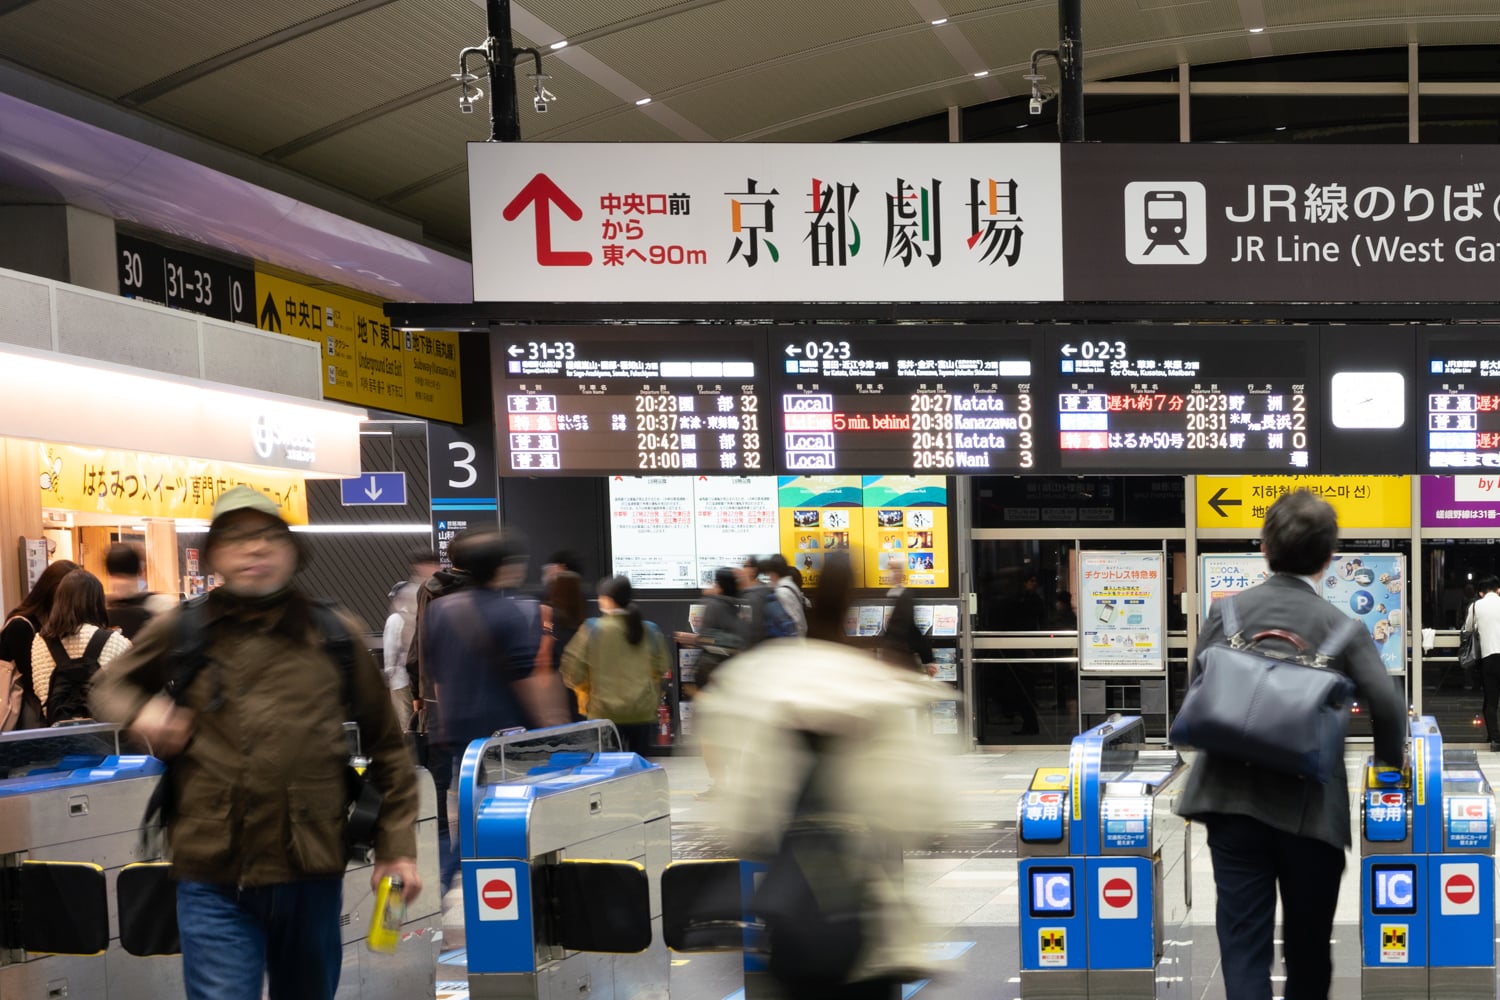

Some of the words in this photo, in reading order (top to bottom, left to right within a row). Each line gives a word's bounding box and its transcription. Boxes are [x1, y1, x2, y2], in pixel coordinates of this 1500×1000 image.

[599, 193, 690, 216] 中央口前
[601, 218, 644, 240] から
[723, 177, 1025, 268] 京都劇場
[602, 243, 707, 266] 東へ90m
[1231, 236, 1264, 263] JR
[1276, 235, 1340, 263] Line
[1352, 234, 1444, 267] (West
[123, 250, 142, 288] 30
[168, 263, 212, 305] 31-33
[233, 281, 242, 313] 0
[285, 296, 322, 331] 中央口
[357, 316, 401, 352] 地下東口
[636, 396, 677, 412] 20:23
[741, 396, 758, 412] 32
[790, 396, 829, 411] Local
[911, 396, 952, 411] 20:27
[954, 396, 1003, 411] Katata
[1018, 395, 1031, 411] 3
[1187, 395, 1227, 411] 20:23
[1293, 395, 1305, 411] 2
[636, 415, 677, 430] 20:37
[742, 415, 757, 430] 31
[834, 415, 845, 430] 5
[873, 415, 910, 430] behind
[912, 415, 952, 430] 20:38
[955, 415, 1017, 430] Kanazawa
[1018, 415, 1031, 430] 0
[1187, 415, 1227, 430] 20:31
[1294, 415, 1305, 430] 2
[638, 434, 678, 449] 20:42
[743, 434, 759, 449] 33
[790, 434, 830, 449] Local
[913, 433, 953, 448] 20:41
[956, 434, 1005, 448] Katata
[1019, 433, 1032, 448] 3
[1109, 433, 1184, 448] はるか50号
[1187, 433, 1227, 448] 20:34
[1294, 433, 1305, 448] 0
[448, 442, 477, 488] 3
[639, 453, 679, 468] 21:00
[744, 452, 760, 468] 32
[791, 452, 831, 467] Local
[913, 452, 954, 467] 20:56
[956, 452, 989, 467] Wani
[1020, 452, 1032, 467] 3
[1353, 485, 1371, 499] 선)
[1478, 478, 1494, 492] by
[1370, 807, 1402, 822] 専用
[1036, 876, 1071, 908] IC
[1378, 869, 1412, 904] IC
